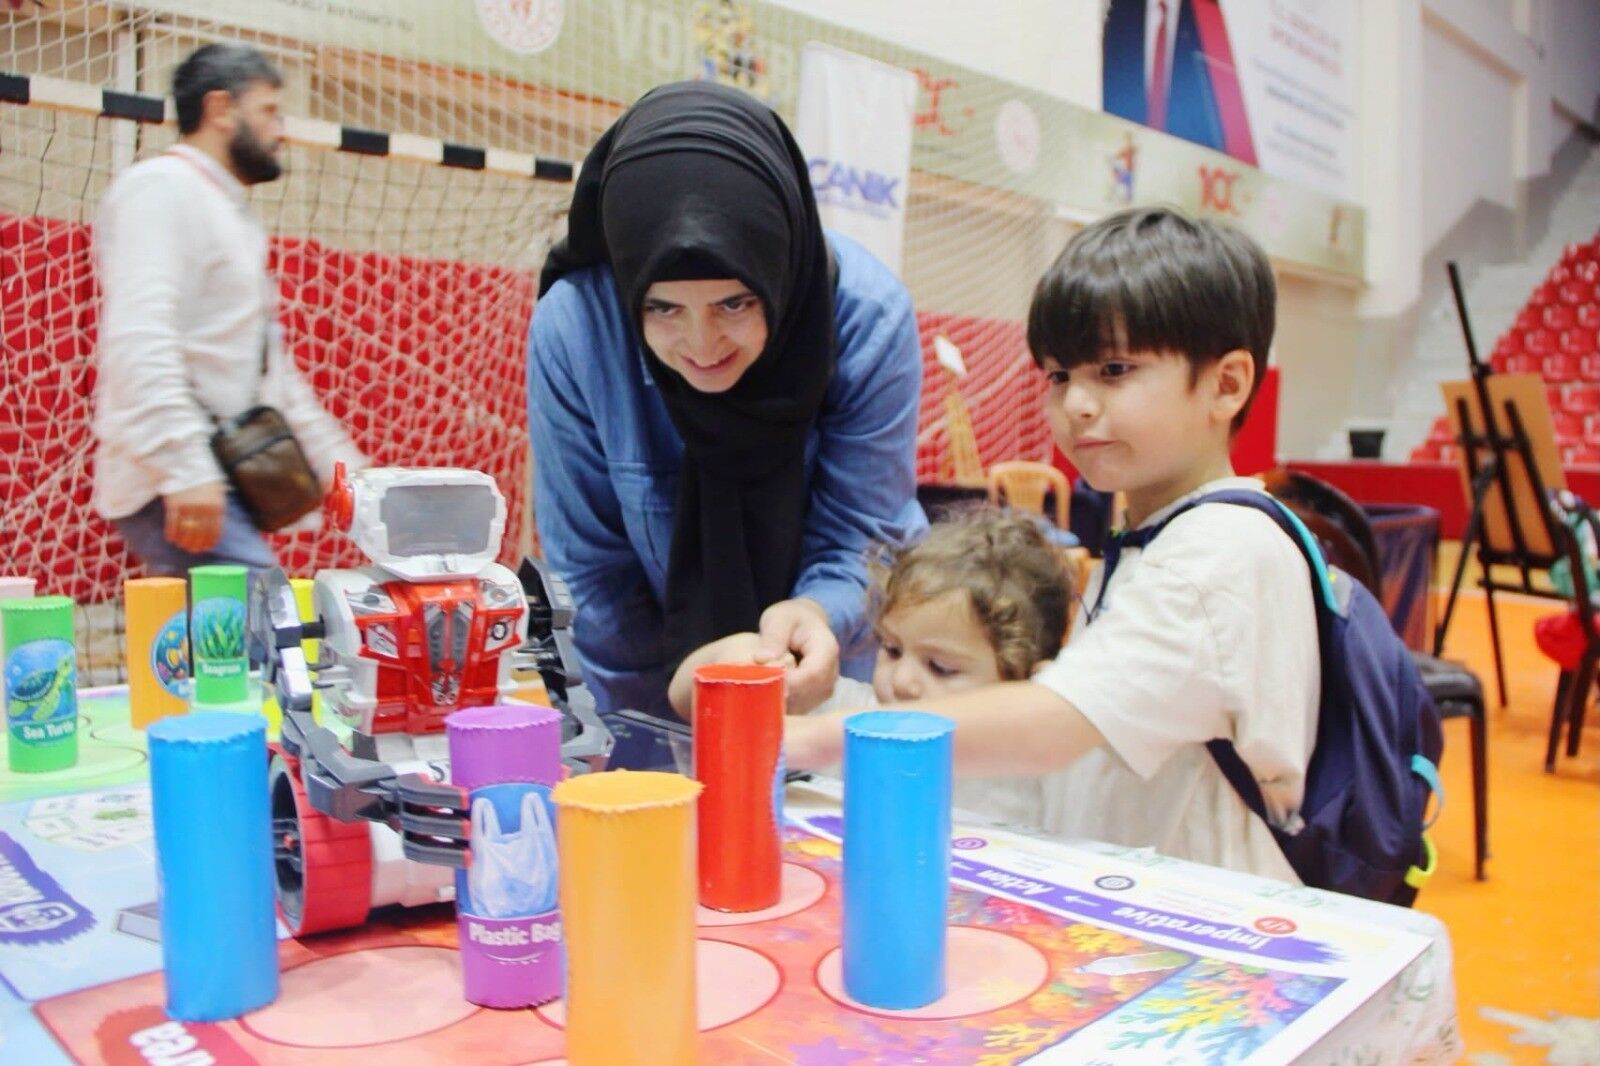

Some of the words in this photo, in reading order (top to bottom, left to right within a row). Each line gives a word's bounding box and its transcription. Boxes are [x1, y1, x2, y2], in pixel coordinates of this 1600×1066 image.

[22, 725, 46, 741] Sea
[46, 720, 75, 738] Turtle
[976, 868, 1057, 896] Action
[468, 921, 530, 947] Plastic
[531, 920, 561, 943] Bag
[1111, 906, 1272, 950] Imperative
